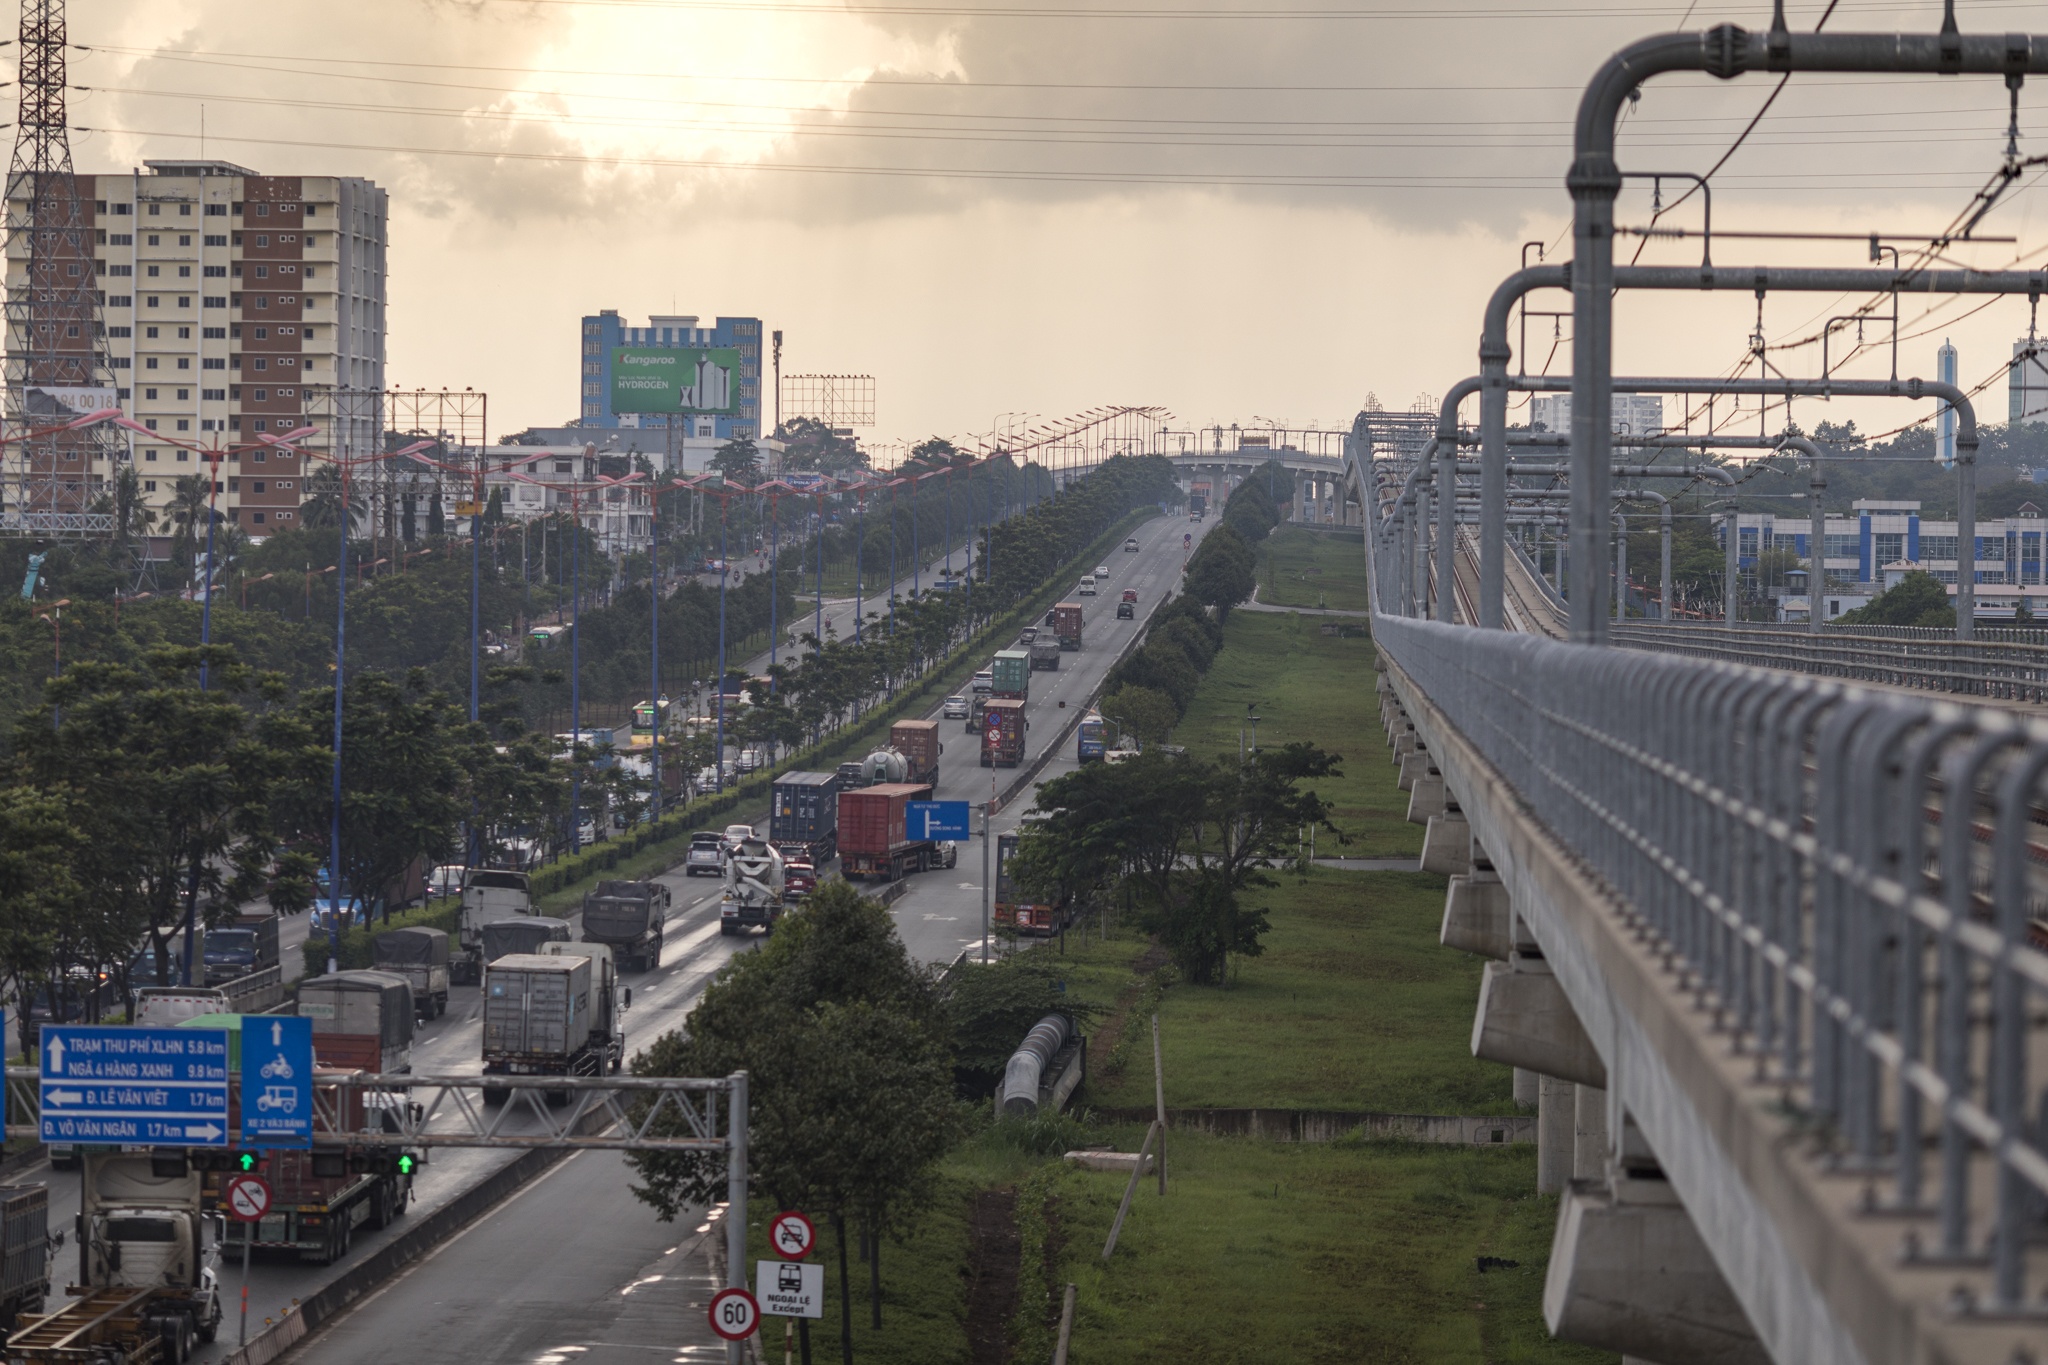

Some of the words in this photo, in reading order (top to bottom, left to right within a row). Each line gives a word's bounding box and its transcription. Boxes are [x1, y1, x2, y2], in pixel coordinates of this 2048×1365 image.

[619, 354, 675, 366] Kangaroo
[618, 380, 669, 389] HYDROGEN
[79, 394, 94, 408] 00
[100, 395, 113, 409] 18
[69, 1038, 102, 1055] TRẠM
[103, 1038, 127, 1053] THU
[129, 1035, 150, 1053] PHÍ
[151, 1039, 184, 1054] XLHN
[187, 1040, 204, 1054] 5.8
[206, 1041, 225, 1055] km
[68, 1060, 94, 1076] NGÃ
[95, 1062, 103, 1076] 4
[104, 1059, 138, 1077] HÀNG
[140, 1063, 174, 1078] XANH
[187, 1064, 204, 1078] 9.8
[206, 1064, 225, 1078] km
[86, 1090, 98, 1105] Đ.
[100, 1088, 116, 1105] LÊ
[117, 1089, 142, 1106] VĂN
[190, 1092, 205, 1106] 1.7
[206, 1092, 225, 1106] km
[44, 1121, 56, 1136] Đ.
[58, 1118, 75, 1136] VÕ
[76, 1119, 101, 1137] VĂN
[102, 1119, 137, 1137] NGÂN
[147, 1122, 162, 1137] 1.7
[163, 1123, 182, 1137] km
[247, 1118, 258, 1128] XE
[259, 1118, 266, 1128] 2
[284, 1118, 307, 1128] BÁNH
[724, 1303, 746, 1324] 60
[772, 1304, 805, 1314] Except
